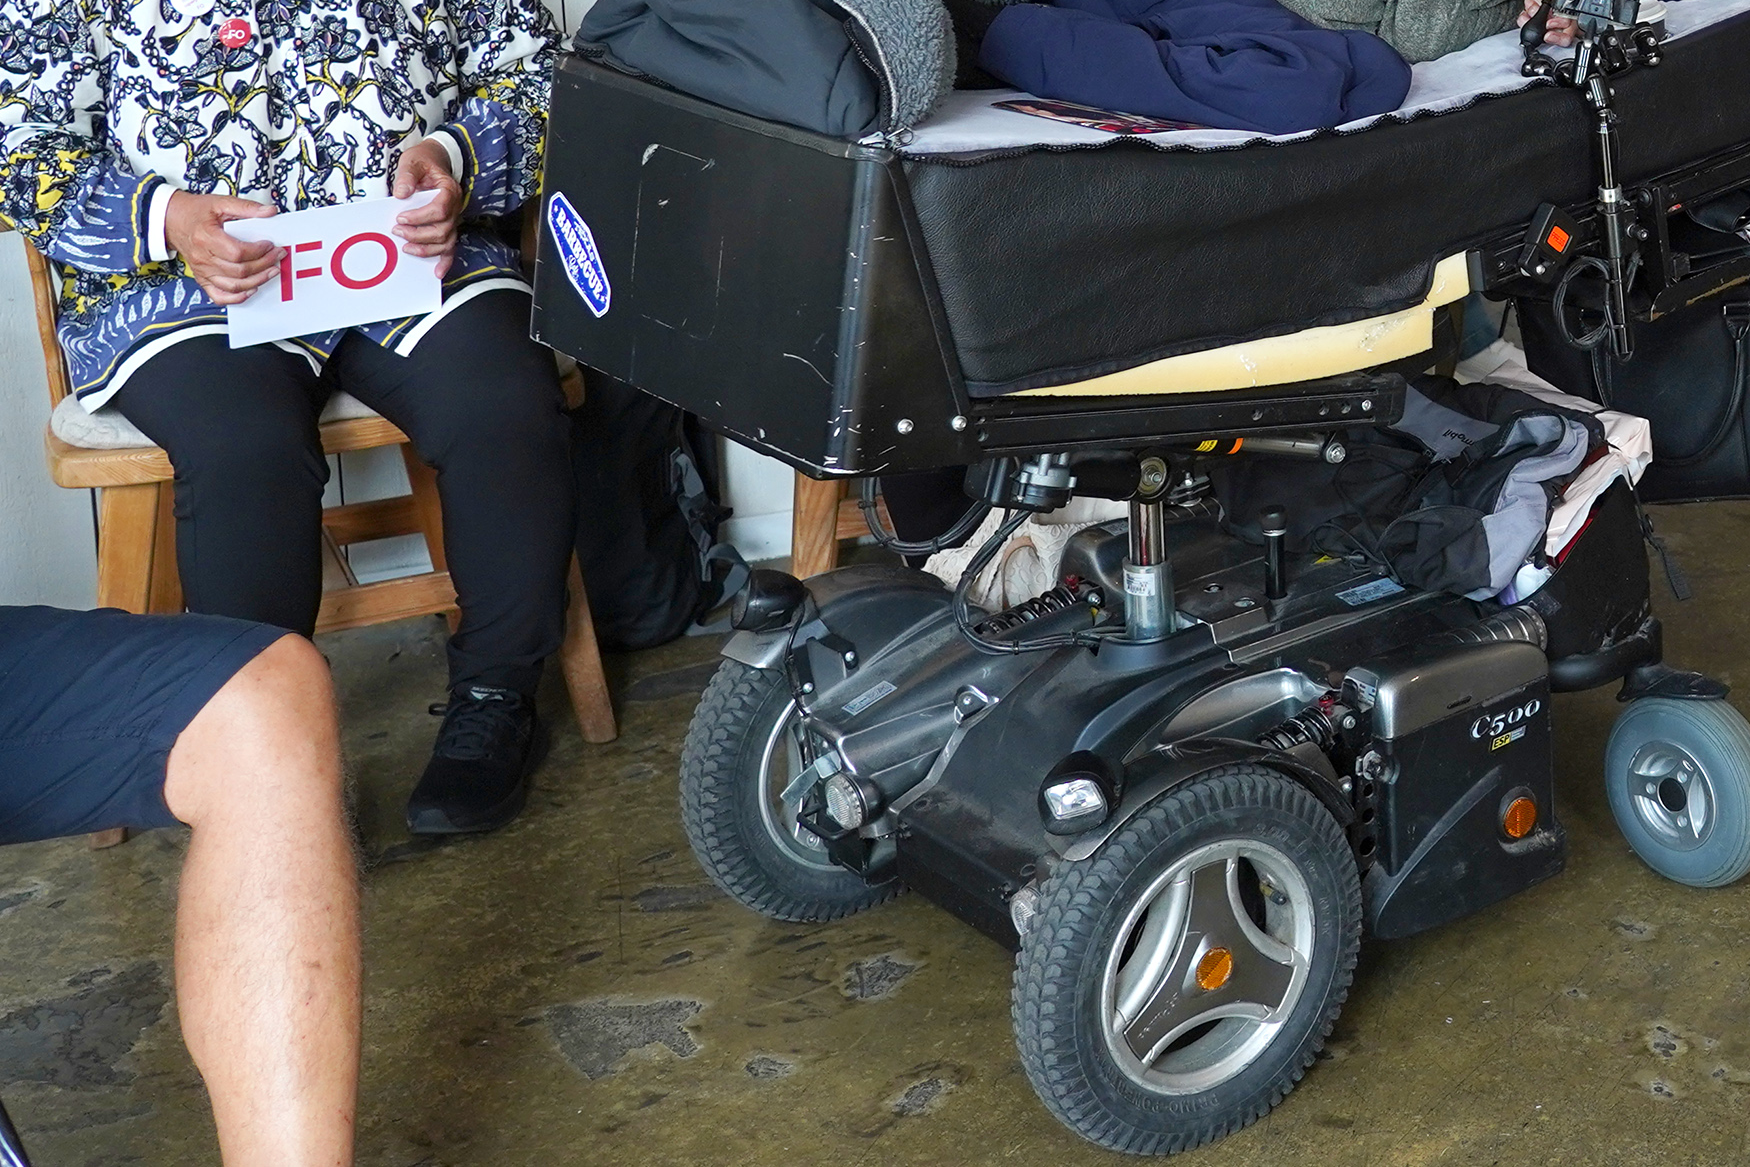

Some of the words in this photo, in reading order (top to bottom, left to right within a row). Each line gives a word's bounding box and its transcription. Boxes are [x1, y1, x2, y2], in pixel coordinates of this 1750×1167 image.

[227, 29, 246, 40] FO
[280, 232, 398, 302] FO
[556, 207, 604, 301] BARBECUE
[1470, 698, 1541, 740] C500
[1493, 734, 1510, 748] ESP
